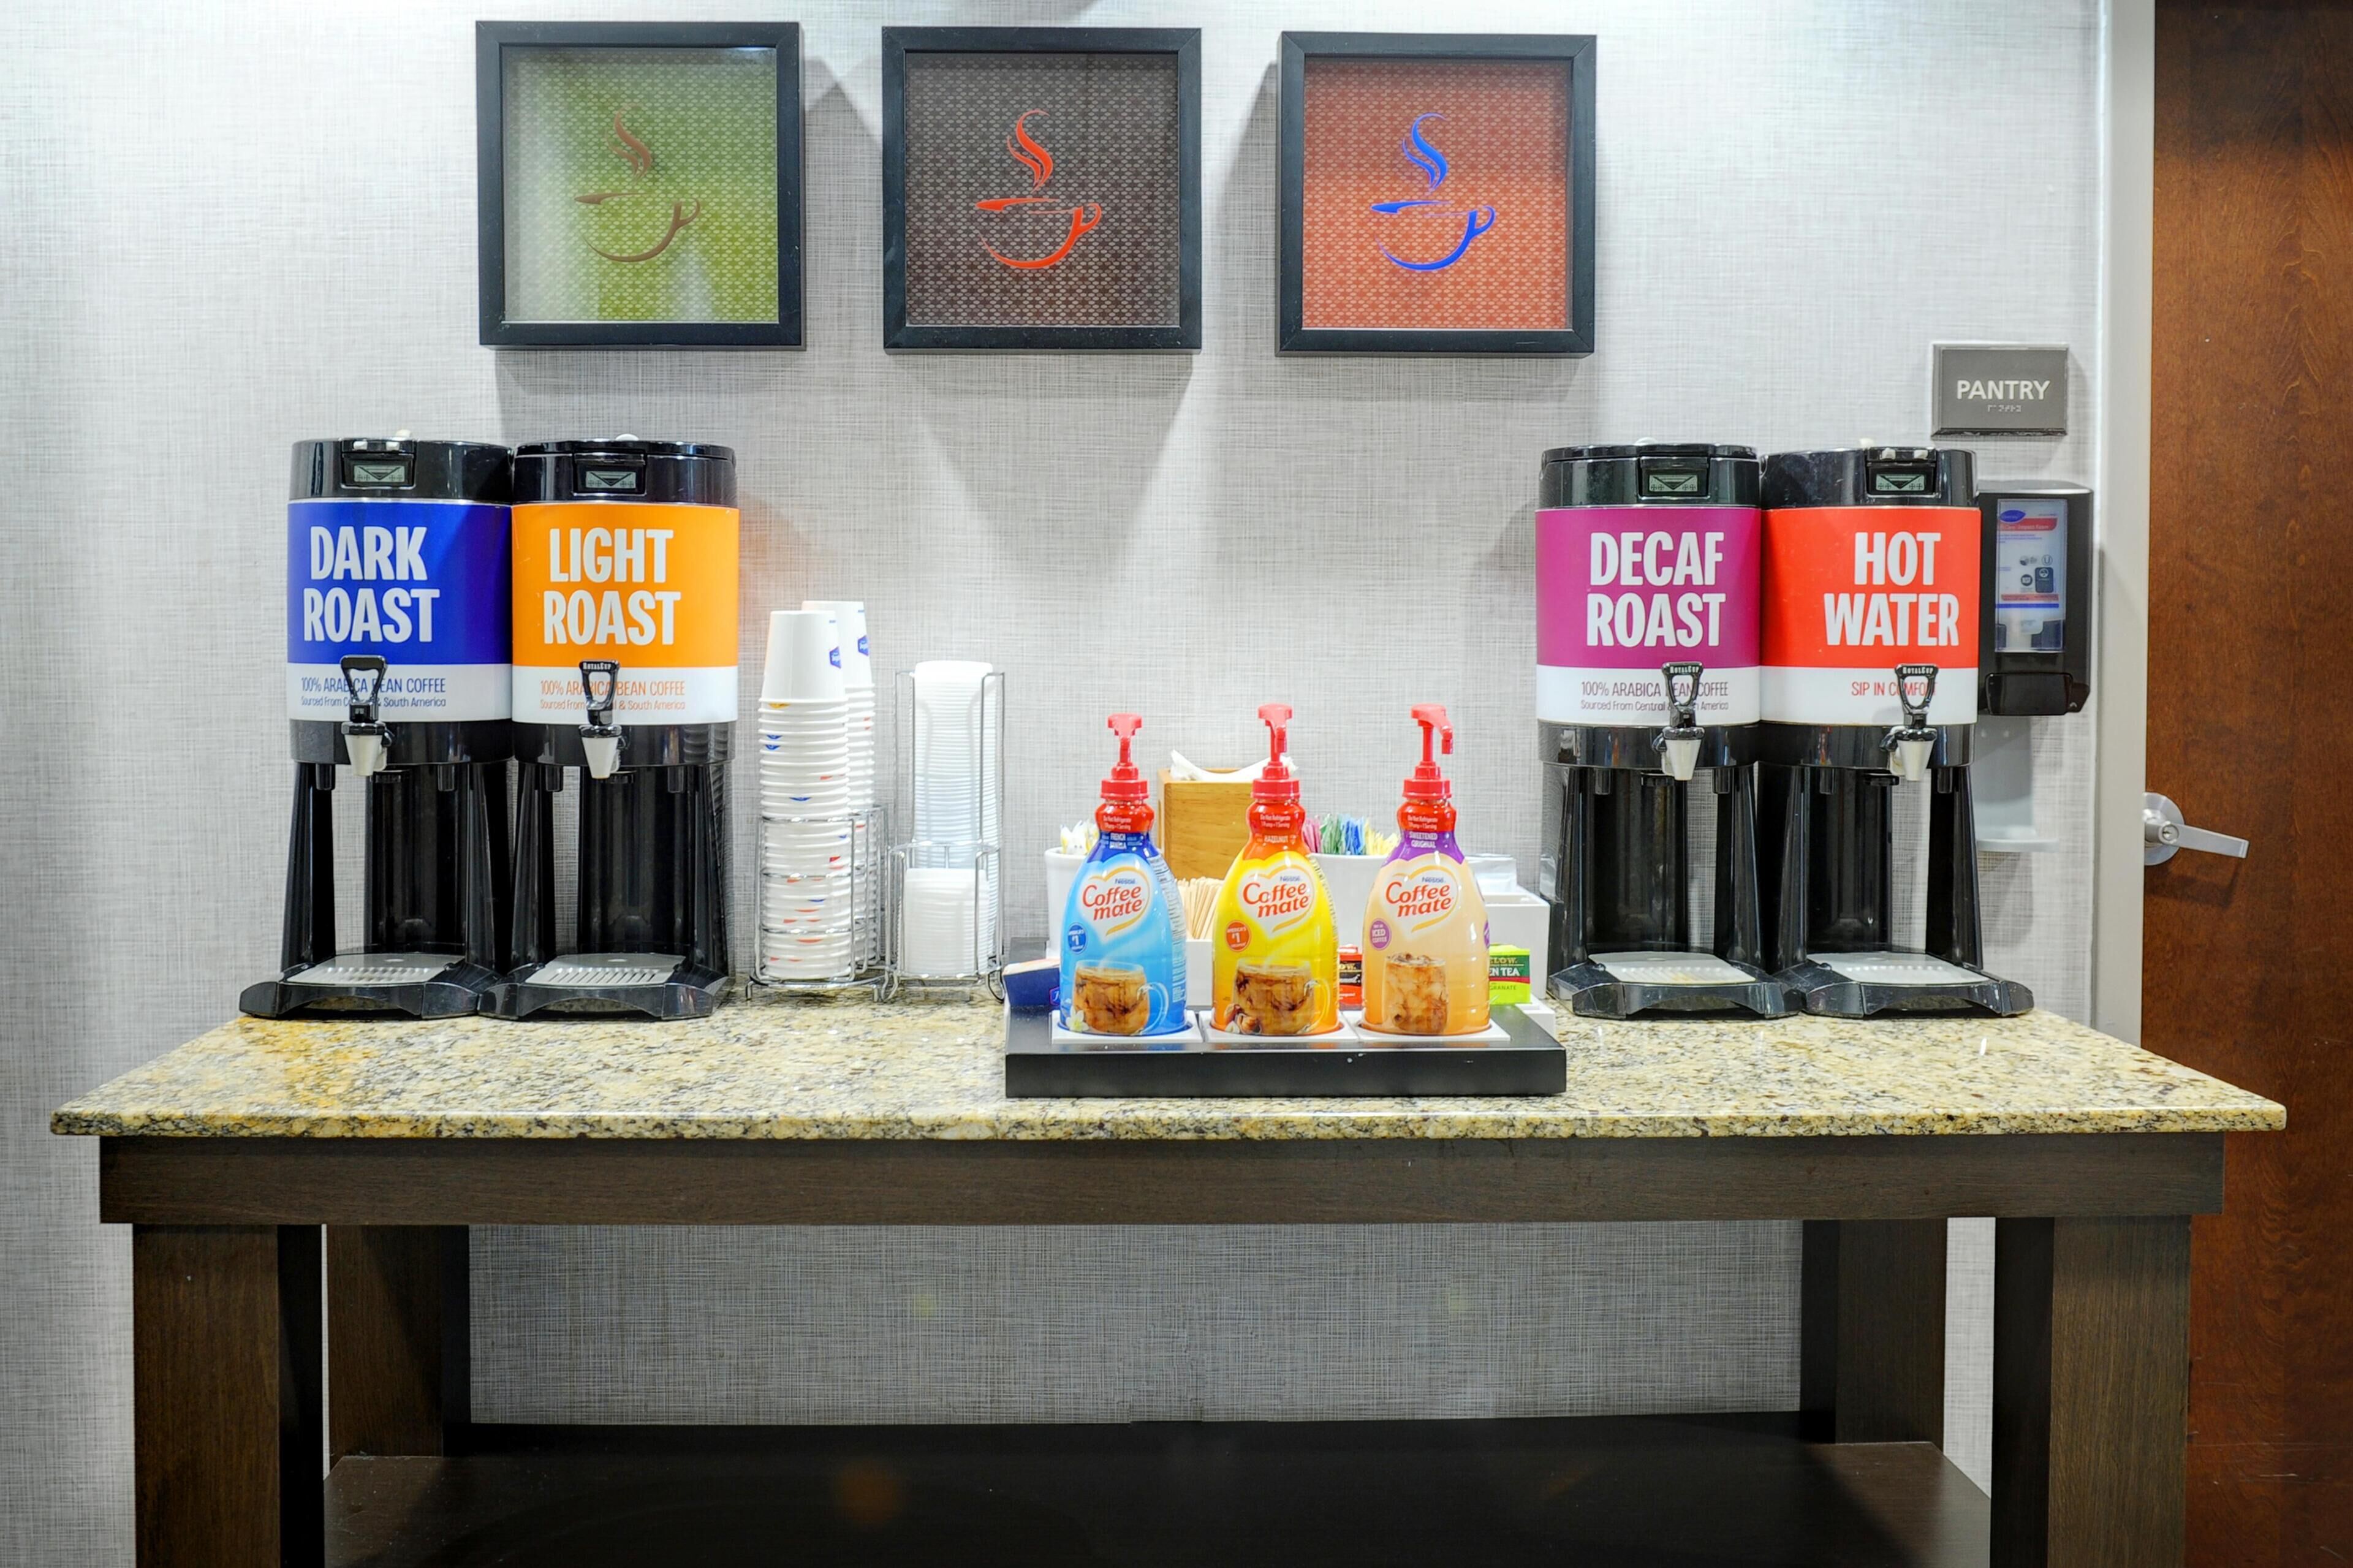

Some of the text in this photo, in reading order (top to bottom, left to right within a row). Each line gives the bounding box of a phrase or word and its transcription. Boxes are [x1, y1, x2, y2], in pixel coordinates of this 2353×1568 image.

[1956, 380, 2050, 402] PANTRY
[310, 526, 428, 580] DARK
[549, 528, 674, 583] LIGHT
[1590, 531, 1725, 586] DECAF
[1854, 532, 1941, 586] HOT
[303, 588, 440, 642] ROAST
[544, 590, 681, 646] ROAST
[1586, 593, 1726, 648] ROAST
[1824, 593, 1960, 648] WATER
[301, 677, 322, 692] 100%
[324, 678, 368, 693] ARABCA
[406, 678, 446, 693] COFFEE
[540, 681, 564, 695] 100%
[615, 681, 646, 696] BEAN
[650, 681, 685, 696] COFFEE
[1582, 681, 1609, 696] 100%
[1612, 681, 1661, 697] ARABICA
[1851, 682, 1870, 696] SIP
[1874, 683, 1885, 696] IN
[324, 697, 342, 706] From
[384, 697, 409, 707] South
[411, 697, 447, 707] America
[540, 700, 566, 710] Sourced
[567, 700, 584, 710] From
[628, 700, 652, 710] South
[653, 700, 685, 710] America
[1581, 700, 1611, 711] Sourced
[1612, 700, 1632, 711] From
[1634, 700, 1665, 711] Central
[1700, 700, 1729, 711] America
[1264, 835, 1288, 844] HAZELNUT
[1083, 885, 1142, 907] Coffee
[1243, 882, 1306, 904] Coffee
[1385, 882, 1450, 904] Coffee
[1094, 900, 1142, 920] mate
[1258, 895, 1309, 918] mate
[1398, 897, 1451, 917] mate
[1500, 968, 1520, 976] TEA
